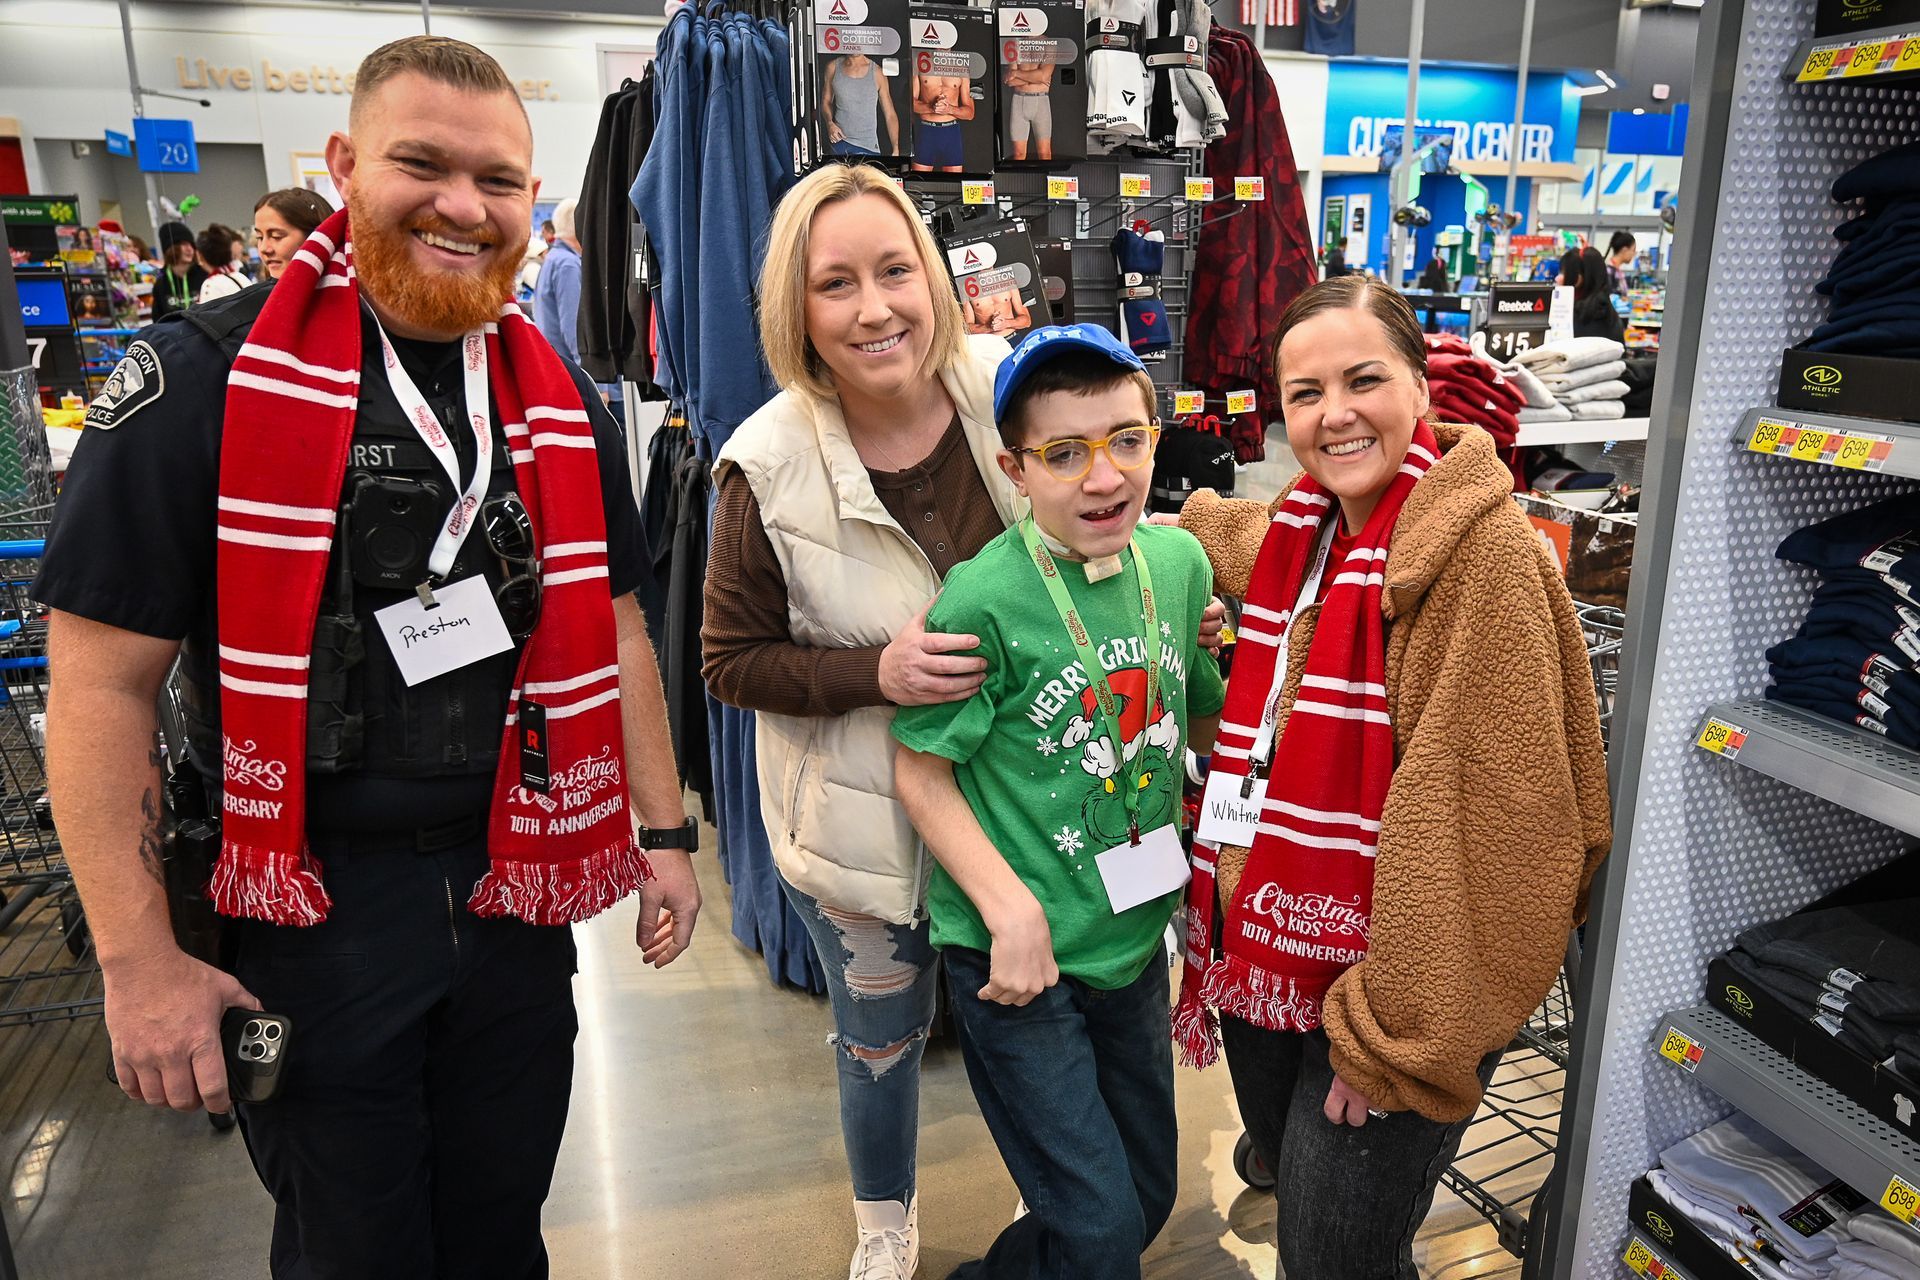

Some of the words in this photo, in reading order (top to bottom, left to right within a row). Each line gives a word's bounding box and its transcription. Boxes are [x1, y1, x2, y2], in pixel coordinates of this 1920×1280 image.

[824, 27, 840, 51] 6
[842, 36, 882, 44] COTTON
[933, 57, 970, 66] COTTON
[1004, 40, 1018, 63] 6
[176, 55, 251, 91] Live
[917, 51, 932, 74] 6
[1472, 121, 1554, 163] CENTER
[160, 143, 189, 165] 20
[978, 266, 1013, 278] PERFORMANCE
[979, 271, 1015, 286] COTTON
[964, 276, 979, 297] 6
[1498, 300, 1534, 313] Reebok
[1801, 384, 1841, 394] ATHLETIC
[1755, 425, 1780, 444] 698
[1797, 432, 1824, 451] 698
[1842, 439, 1869, 459] 698
[399, 615, 471, 649] Preston
[1705, 725, 1728, 742] 698
[510, 815, 540, 836] 10TH
[547, 793, 623, 836] ANNIVERSARY
[1242, 921, 1271, 945] 10TH
[1666, 1035, 1686, 1053] 698
[1630, 1246, 1649, 1265] 698
